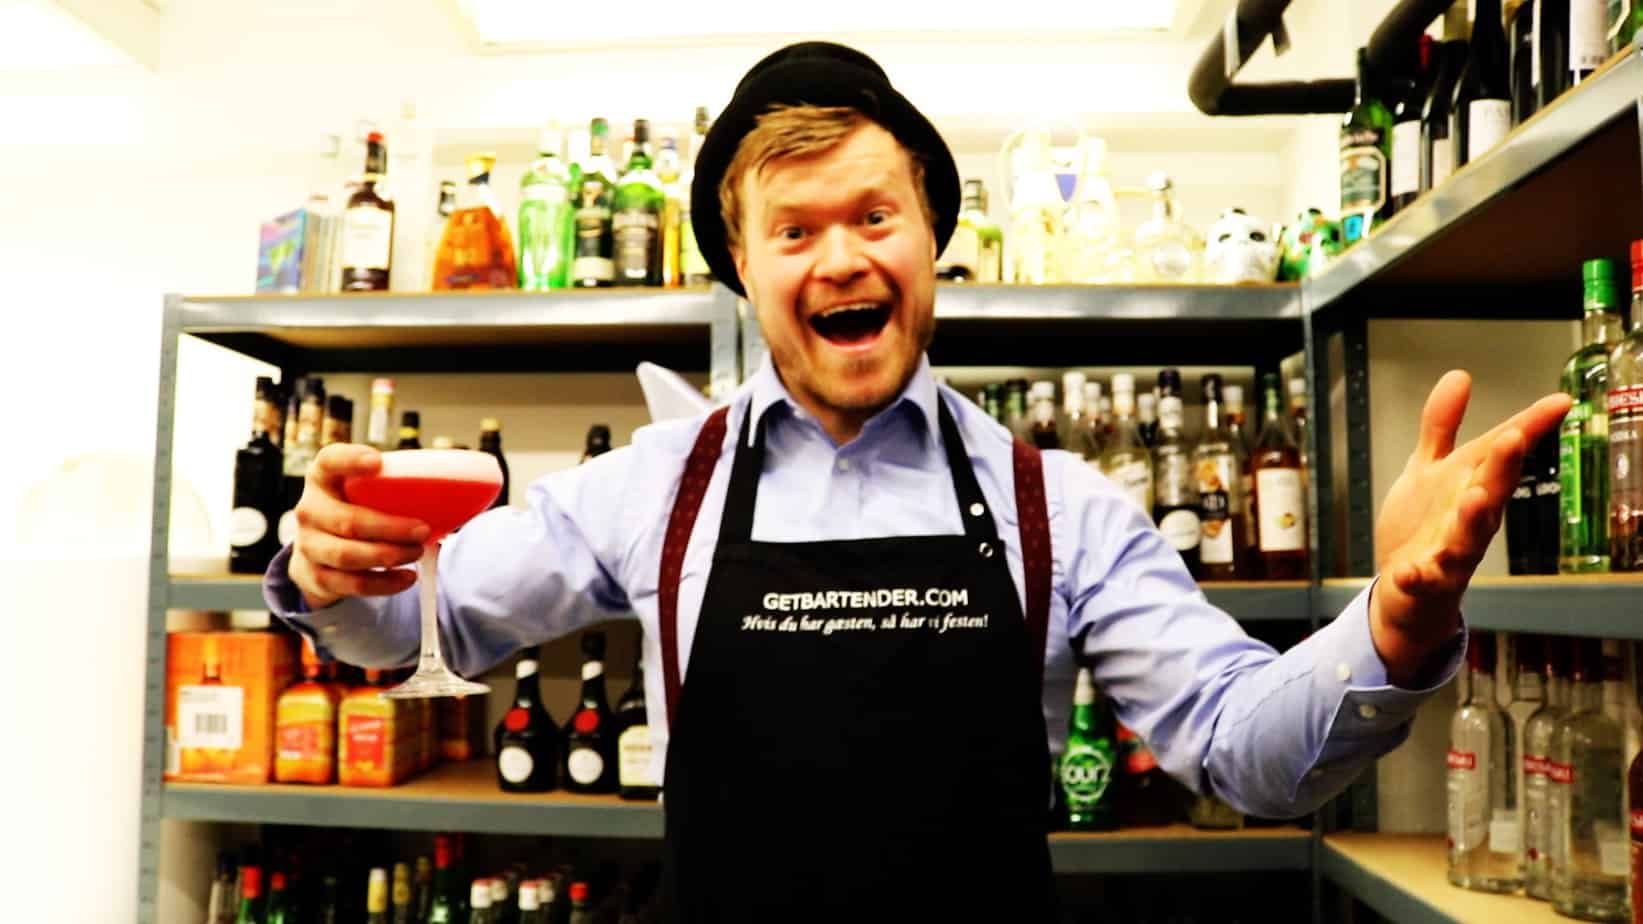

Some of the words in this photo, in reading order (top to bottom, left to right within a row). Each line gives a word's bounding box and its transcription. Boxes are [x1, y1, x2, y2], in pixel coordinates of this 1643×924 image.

[763, 587, 968, 611] GETBARTENDER.COM
[741, 614, 777, 631] Hvis
[778, 615, 799, 632] du
[800, 614, 825, 631] har
[880, 613, 897, 629] så
[900, 611, 927, 629] har
[938, 611, 989, 634] festen!
